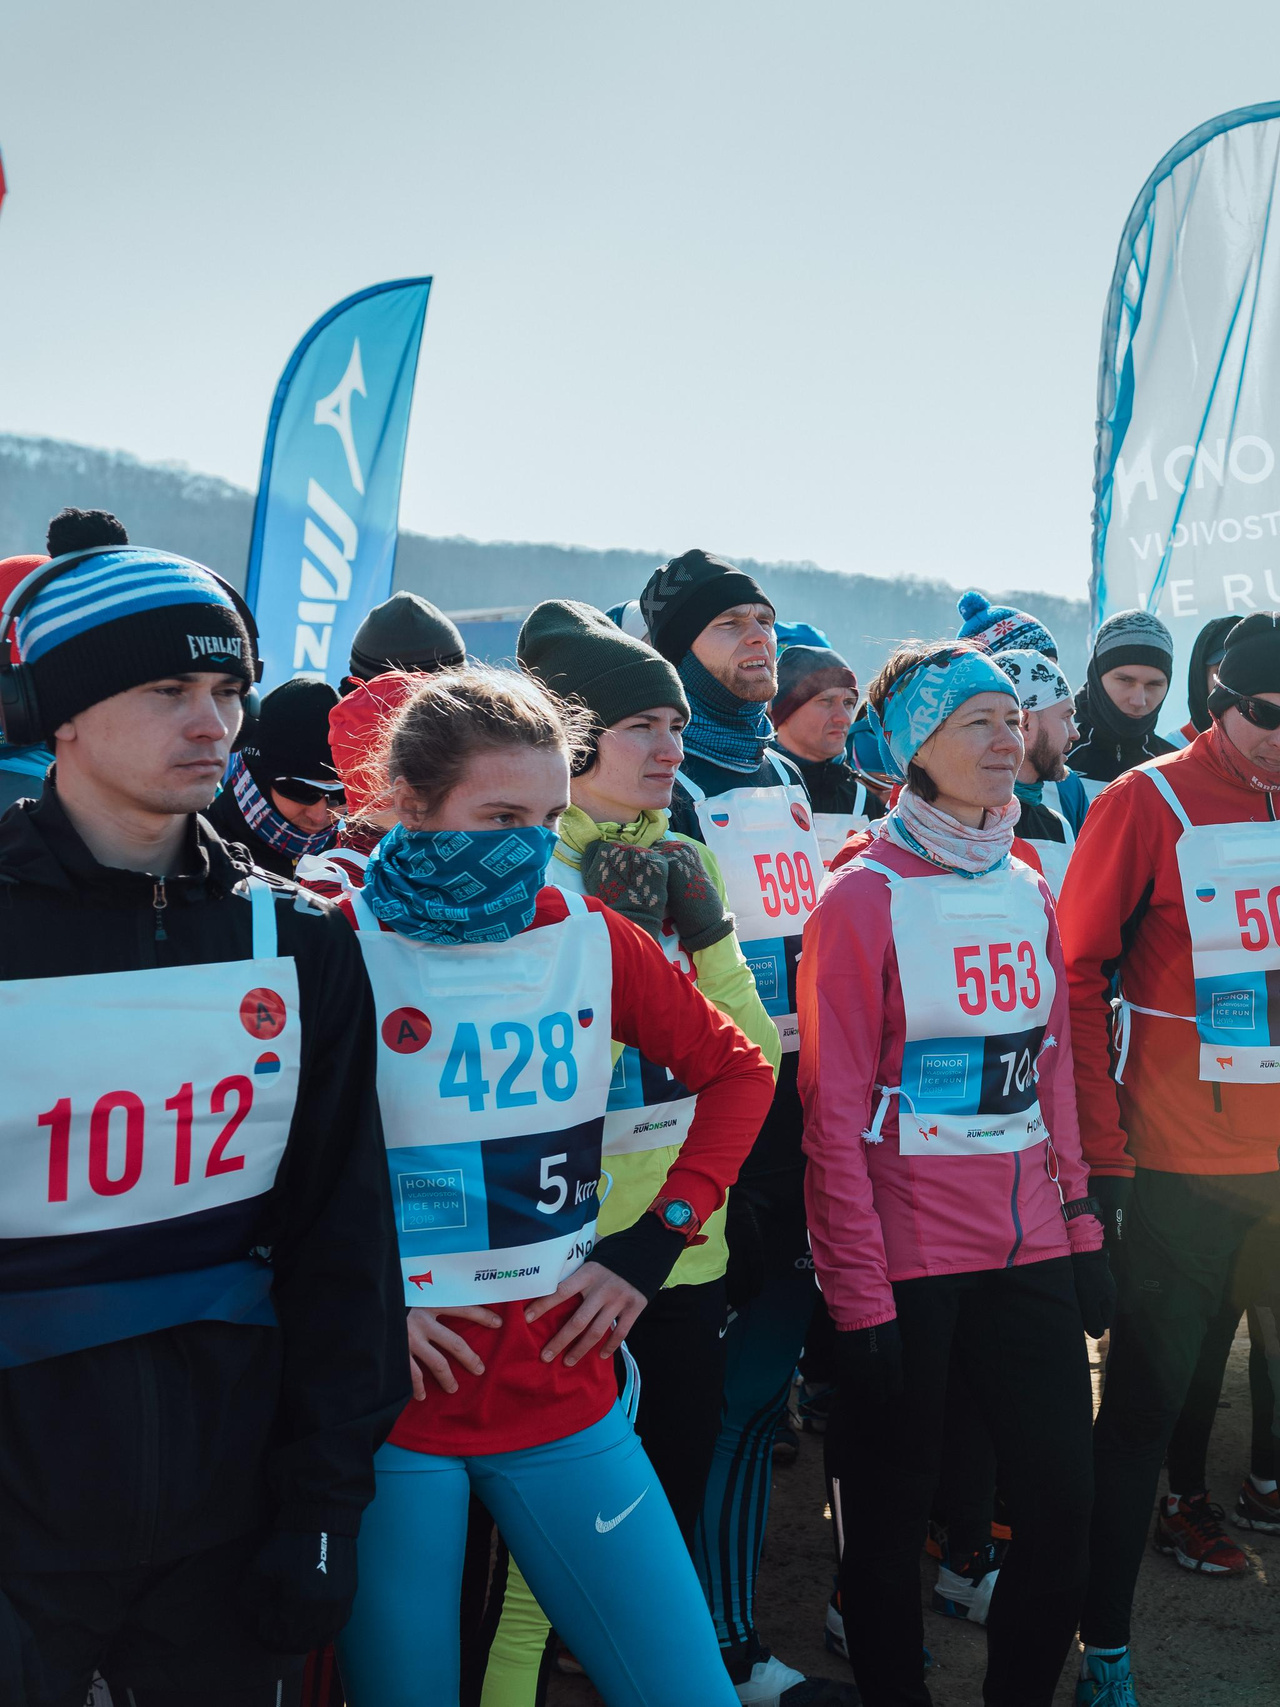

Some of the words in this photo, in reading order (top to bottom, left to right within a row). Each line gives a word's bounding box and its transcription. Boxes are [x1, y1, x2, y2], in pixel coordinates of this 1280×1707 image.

[293, 477, 358, 682] MIZ
[186, 634, 243, 660] EVERLAST
[440, 842, 453, 857] ICE
[448, 833, 468, 850] RUN
[485, 839, 519, 866] VLADIVOSTOK
[493, 861, 511, 874] ICE
[507, 845, 530, 864] RUN
[462, 881, 481, 895] RUN
[752, 850, 817, 918] 599
[430, 908, 443, 919] ICE
[444, 908, 463, 919] RUN
[488, 899, 505, 912] ICE
[748, 961, 773, 971] ONOR
[953, 940, 1041, 1016] 553
[758, 979, 775, 987] RUN
[1216, 993, 1250, 1002] HONOR
[255, 1001, 277, 1030] A
[396, 1019, 419, 1045] A
[439, 1011, 578, 1112] 428
[926, 1059, 963, 1068] HONOR
[37, 1074, 254, 1203] 1012
[405, 1176, 457, 1189] HONOR
[535, 1152, 568, 1215] 5
[574, 1178, 598, 1205] km
[407, 1191, 458, 1199] VLADIVOSTOK
[408, 1202, 429, 1211] ICE
[433, 1201, 459, 1210] RUN
[409, 1214, 435, 1226] 2019
